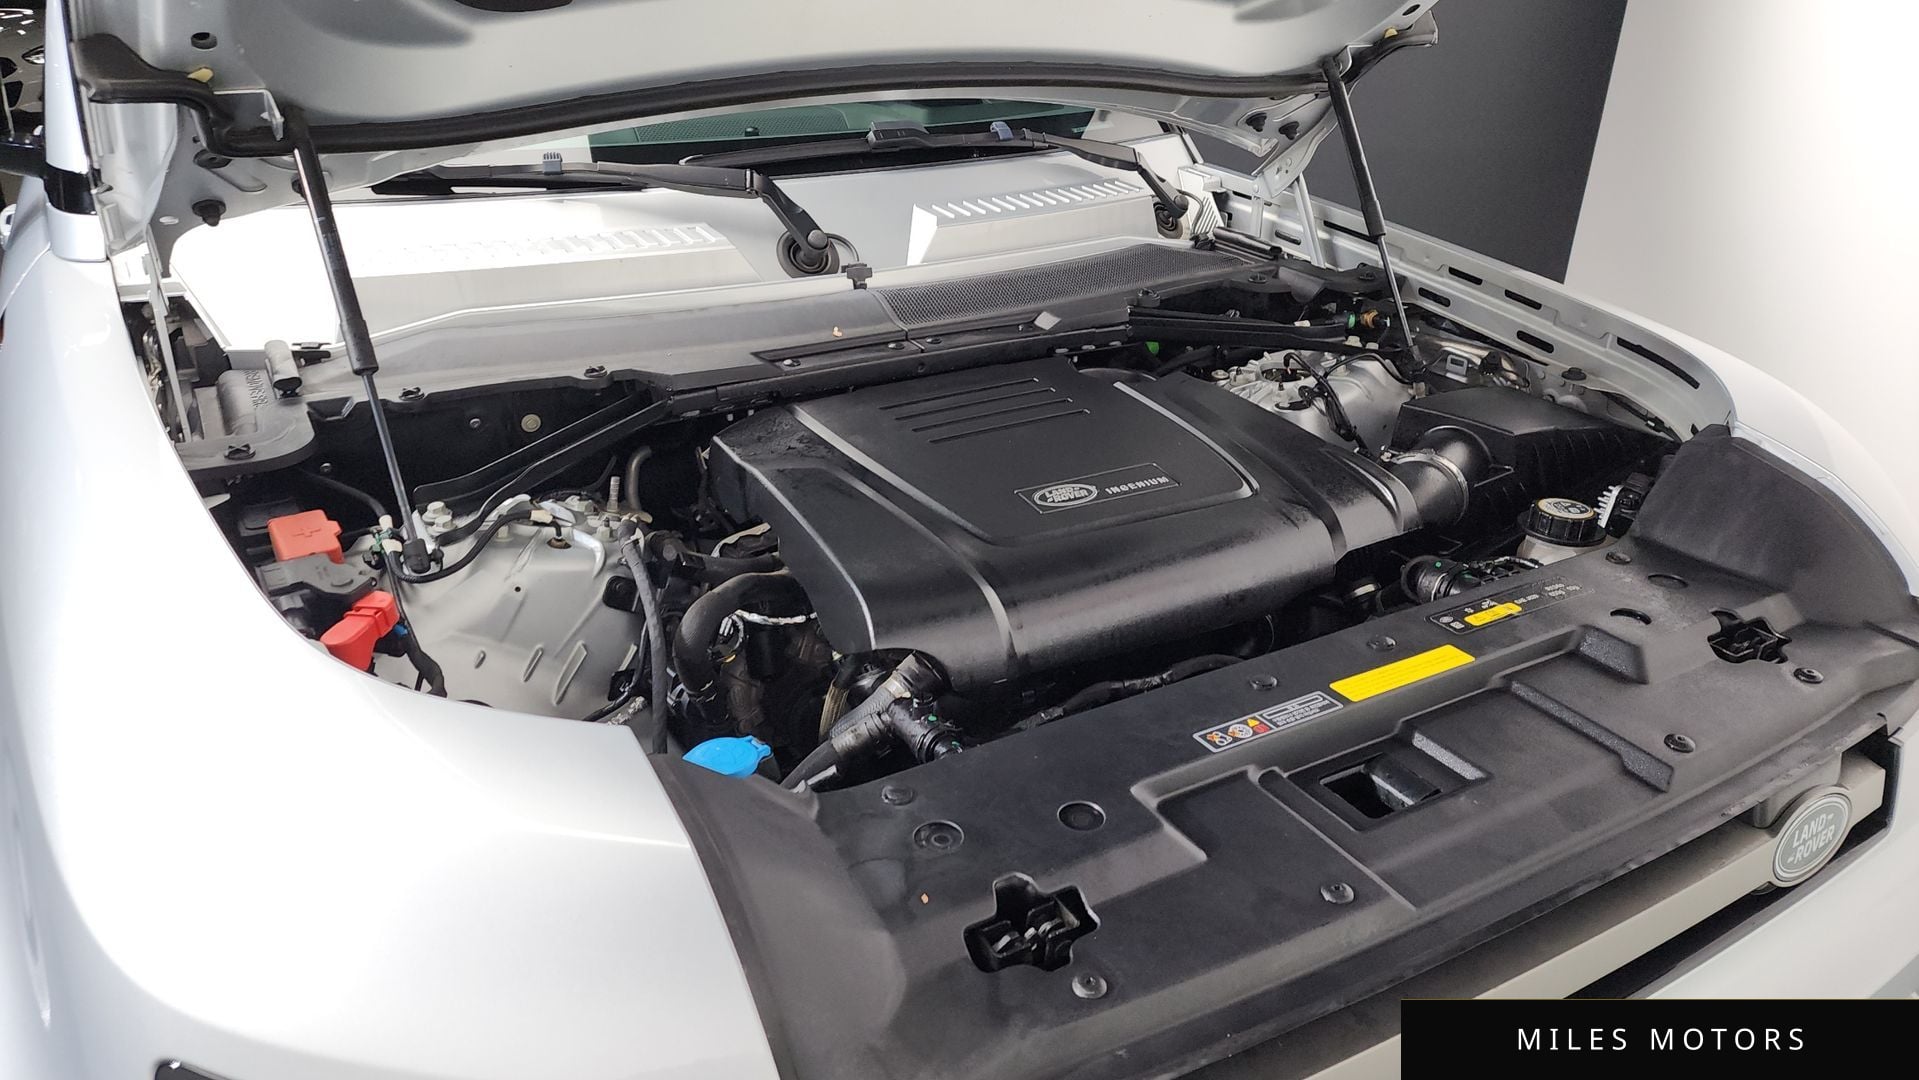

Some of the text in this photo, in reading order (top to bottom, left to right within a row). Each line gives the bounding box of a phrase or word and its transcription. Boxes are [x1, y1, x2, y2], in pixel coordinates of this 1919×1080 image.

[1044, 486, 1074, 499] LAND
[1105, 476, 1170, 495] INGENIUM
[1053, 488, 1089, 503] ROVER
[1792, 813, 1827, 849] LAND
[1793, 824, 1835, 865] ROVER
